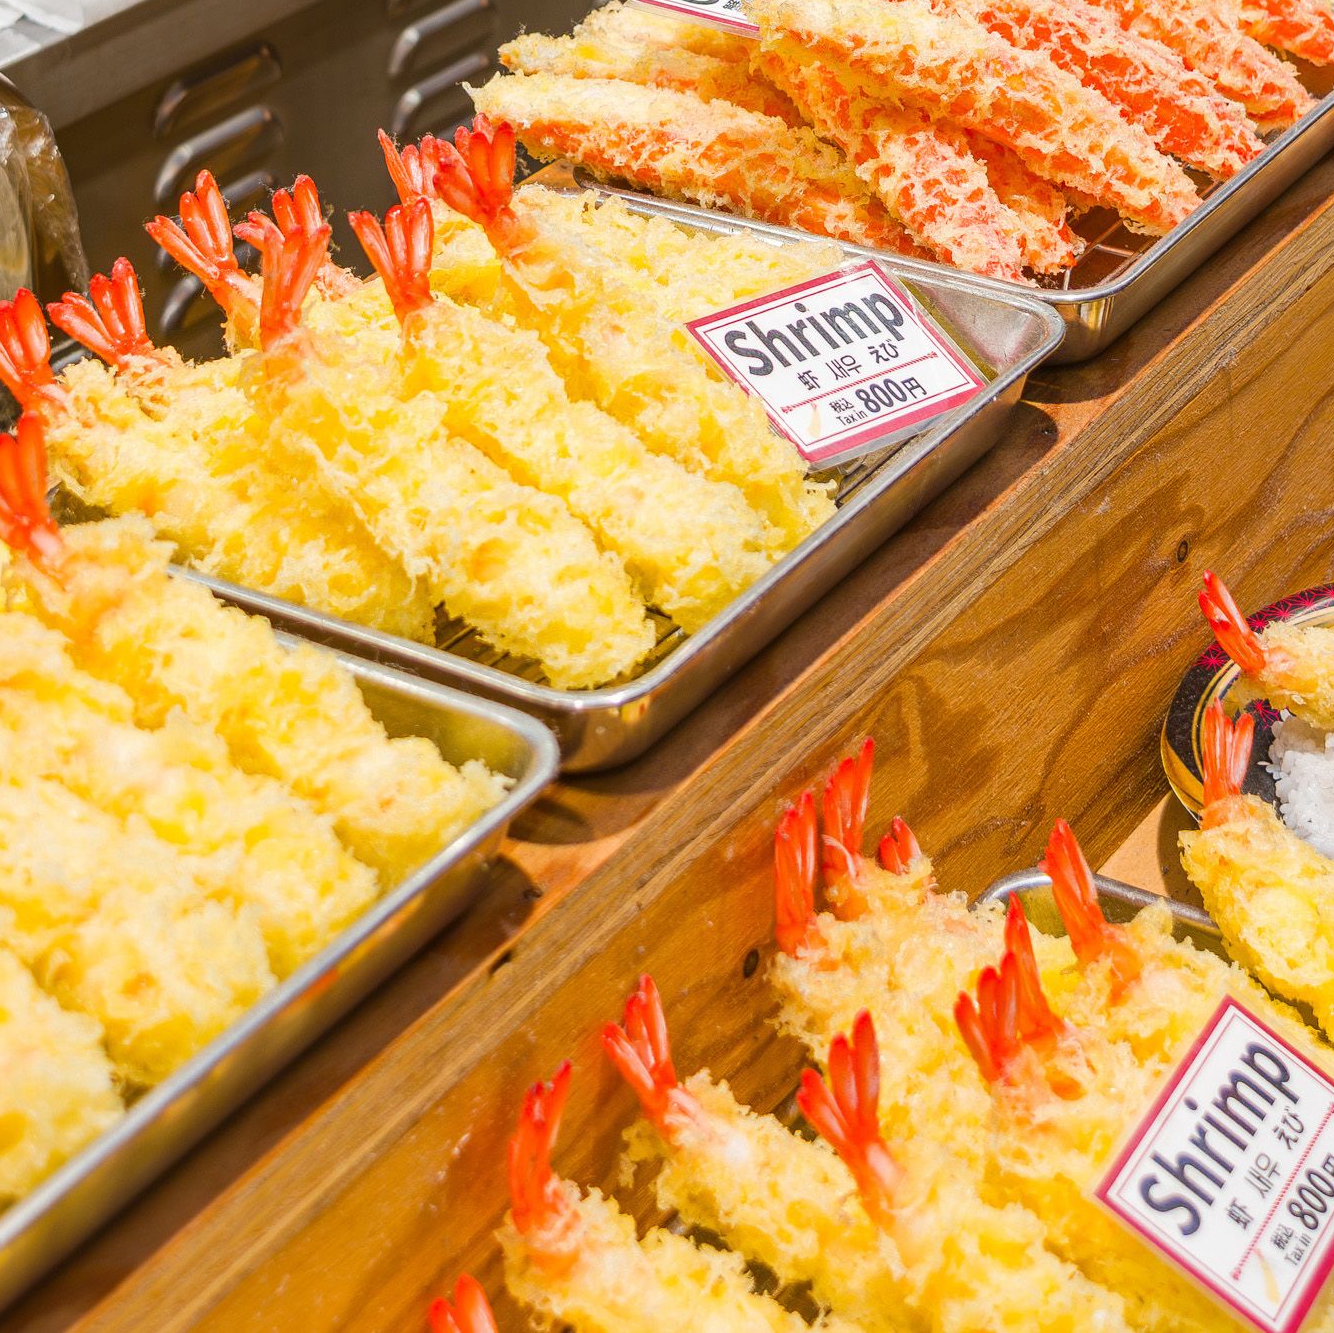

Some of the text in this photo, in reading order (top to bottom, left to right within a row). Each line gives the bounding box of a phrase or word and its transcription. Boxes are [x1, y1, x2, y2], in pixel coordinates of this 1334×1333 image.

[724, 292, 904, 377] Shrimp
[797, 339, 899, 391] 虾 새우 えび
[829, 376, 927, 414] 税込 800円
[836, 409, 869, 426] Tax in
[1139, 1041, 1300, 1236] Shrimp
[1226, 1105, 1304, 1230] 虾 새우 えび
[1284, 1244, 1305, 1266] Tax
